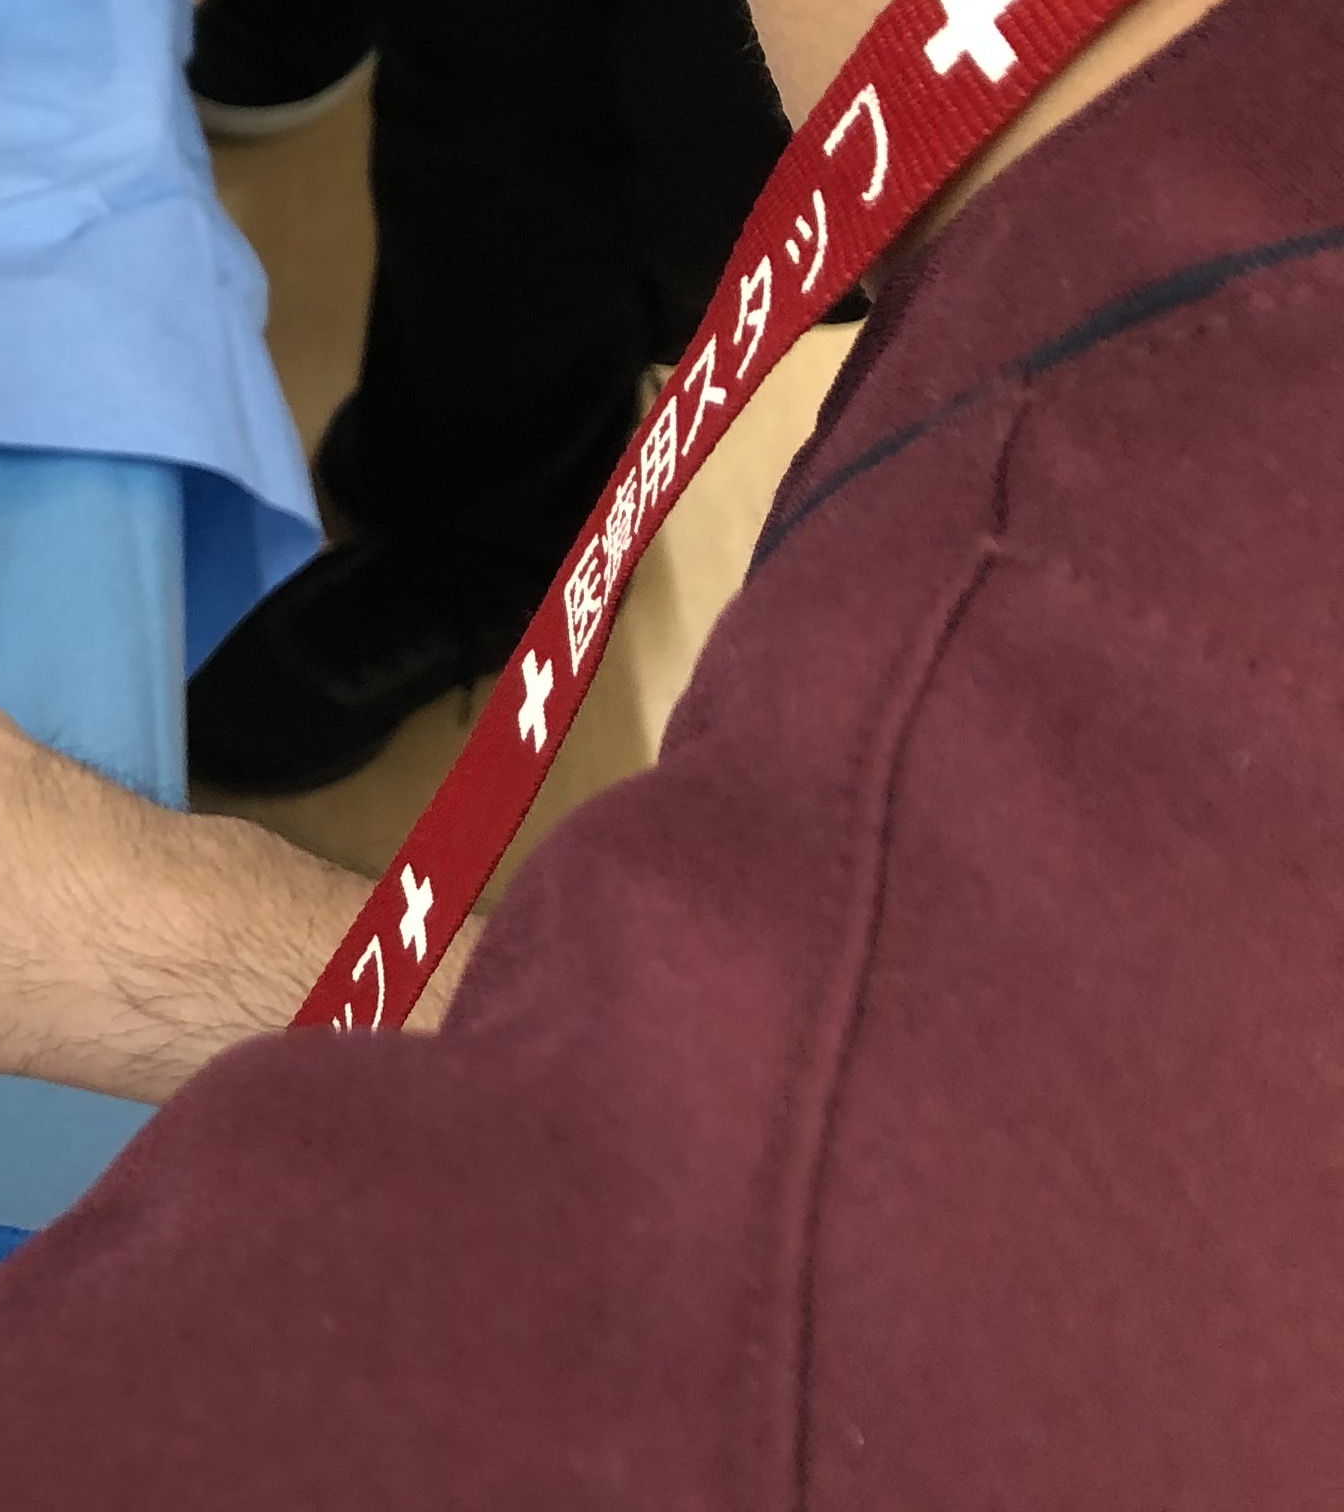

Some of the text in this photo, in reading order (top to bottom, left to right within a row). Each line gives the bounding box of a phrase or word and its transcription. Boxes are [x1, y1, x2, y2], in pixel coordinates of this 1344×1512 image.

[563, 83, 890, 676] 医療用スタッフ
